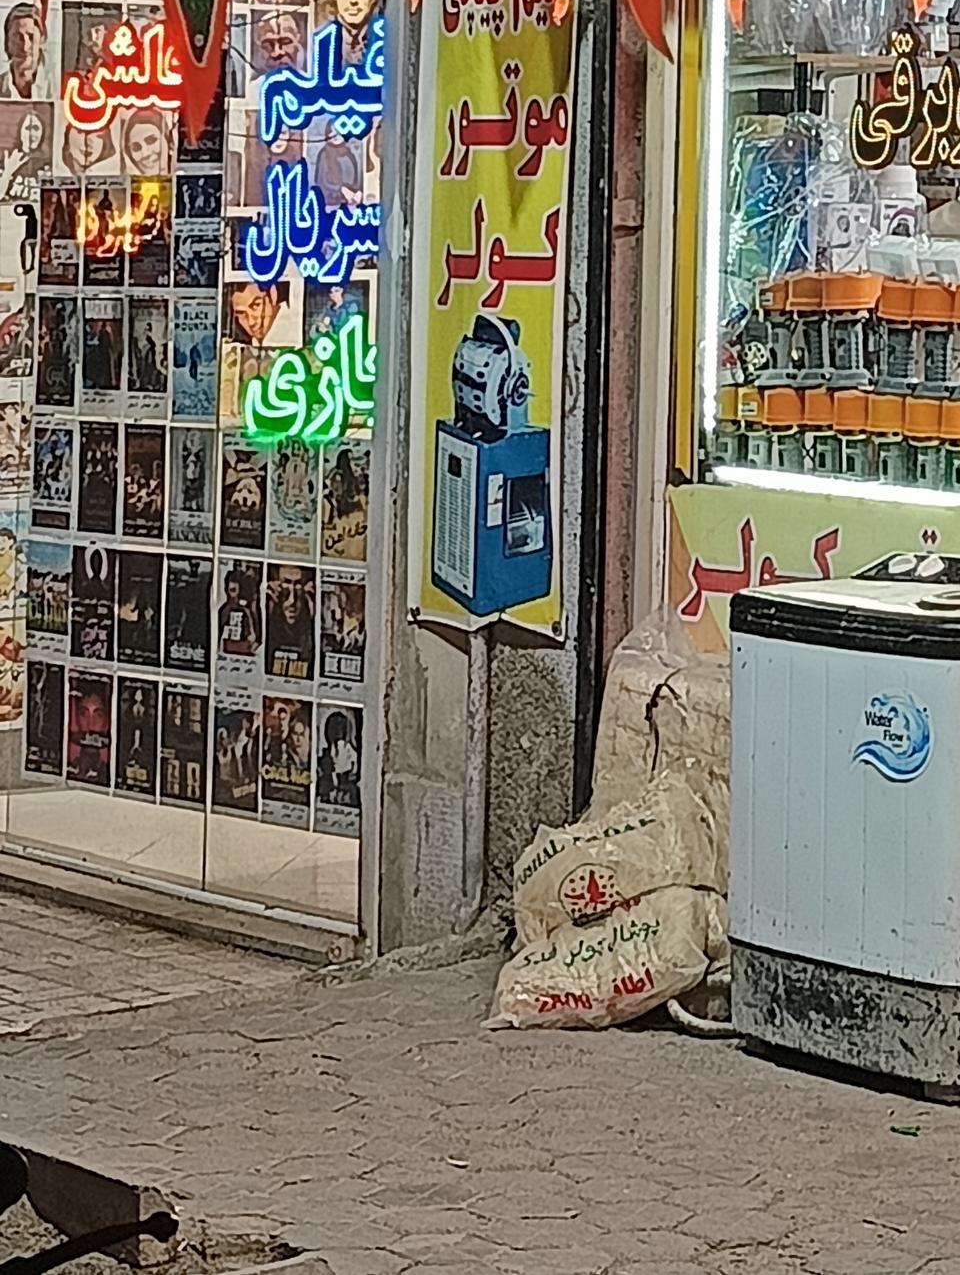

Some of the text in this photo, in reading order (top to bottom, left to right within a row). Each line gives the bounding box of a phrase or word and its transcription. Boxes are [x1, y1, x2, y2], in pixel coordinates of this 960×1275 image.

[439, 61, 570, 177] موتور
[436, 197, 561, 310] کولر
[864, 710, 894, 728] Water
[882, 729, 904, 743] Flow
